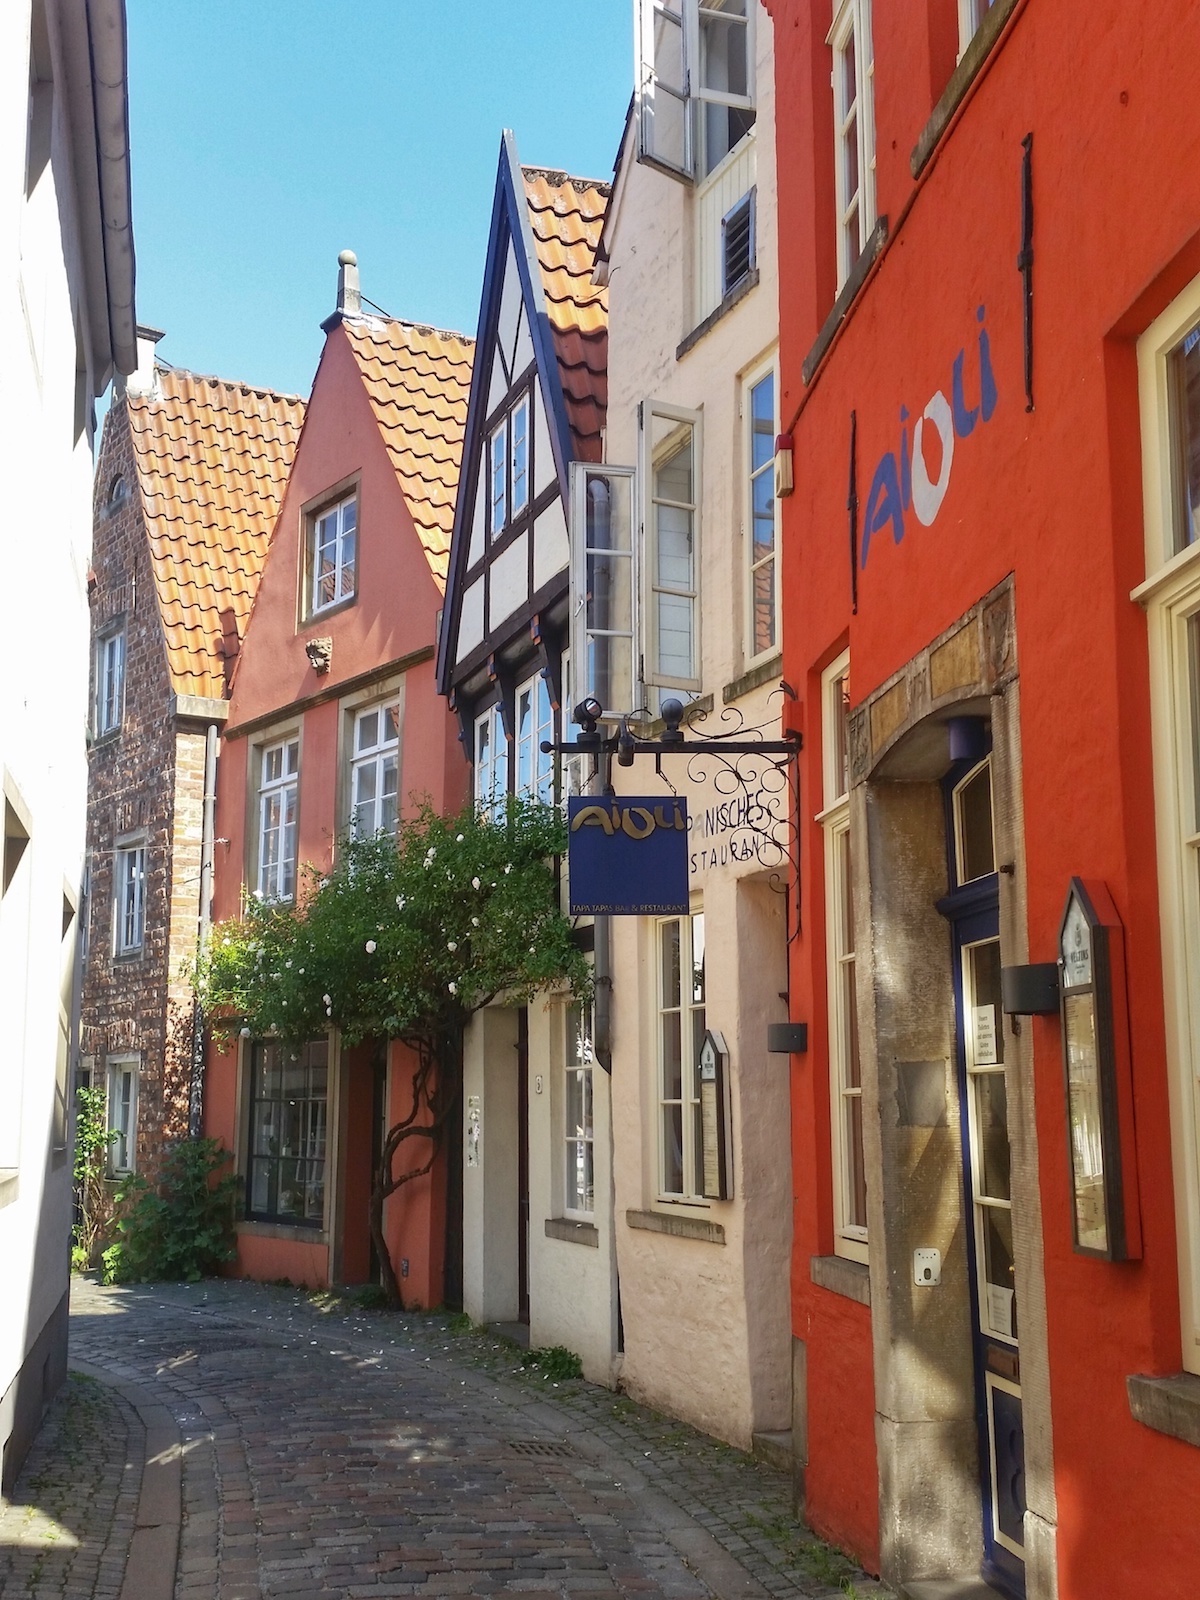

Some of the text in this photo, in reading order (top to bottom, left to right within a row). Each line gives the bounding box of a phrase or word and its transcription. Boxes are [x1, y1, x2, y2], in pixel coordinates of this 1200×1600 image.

[690, 831, 768, 874] STAURANT
[572, 904, 590, 912] TAPA
[592, 904, 613, 912] TAPAS
[631, 904, 638, 912] &
[639, 904, 686, 912] RESTAURANT
